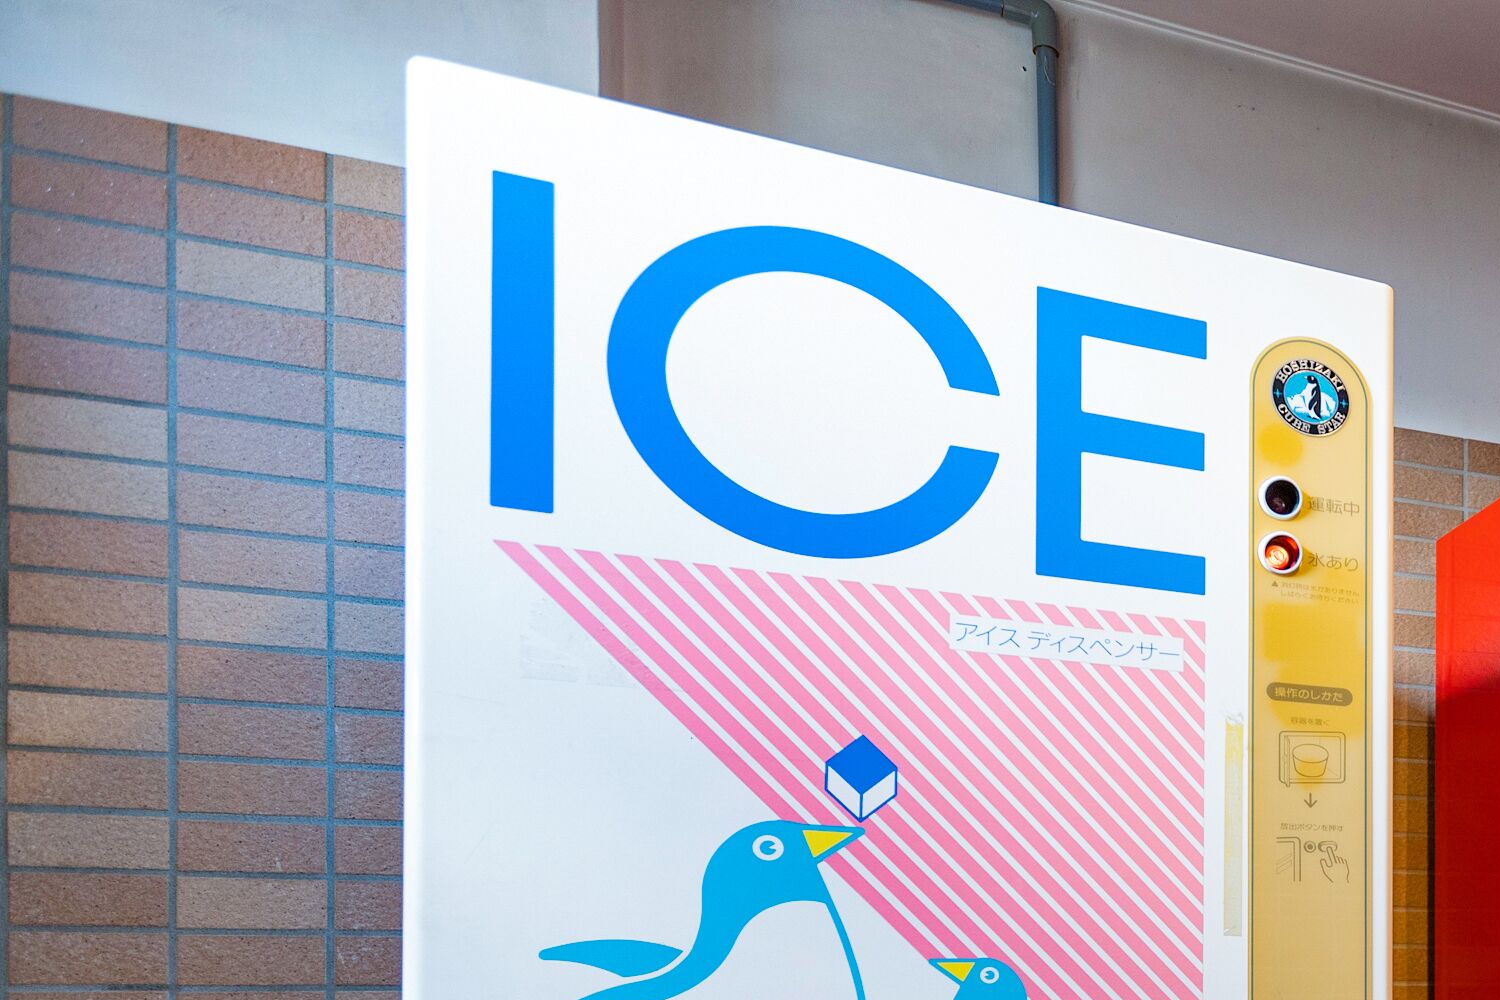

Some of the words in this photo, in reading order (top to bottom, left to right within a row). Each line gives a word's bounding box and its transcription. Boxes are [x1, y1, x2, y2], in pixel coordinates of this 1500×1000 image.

[490, 170, 1207, 596] ICE
[1276, 359, 1346, 392] HOSHIZAKI
[1278, 403, 1311, 433] CUBE
[1317, 411, 1345, 434] STAR
[1308, 496, 1360, 516] 運転中
[1309, 553, 1359, 571] 氷あり
[955, 622, 1021, 648] アイス
[1027, 630, 1180, 661] ディスペンサー
[1274, 687, 1344, 702] 操作のしかた
